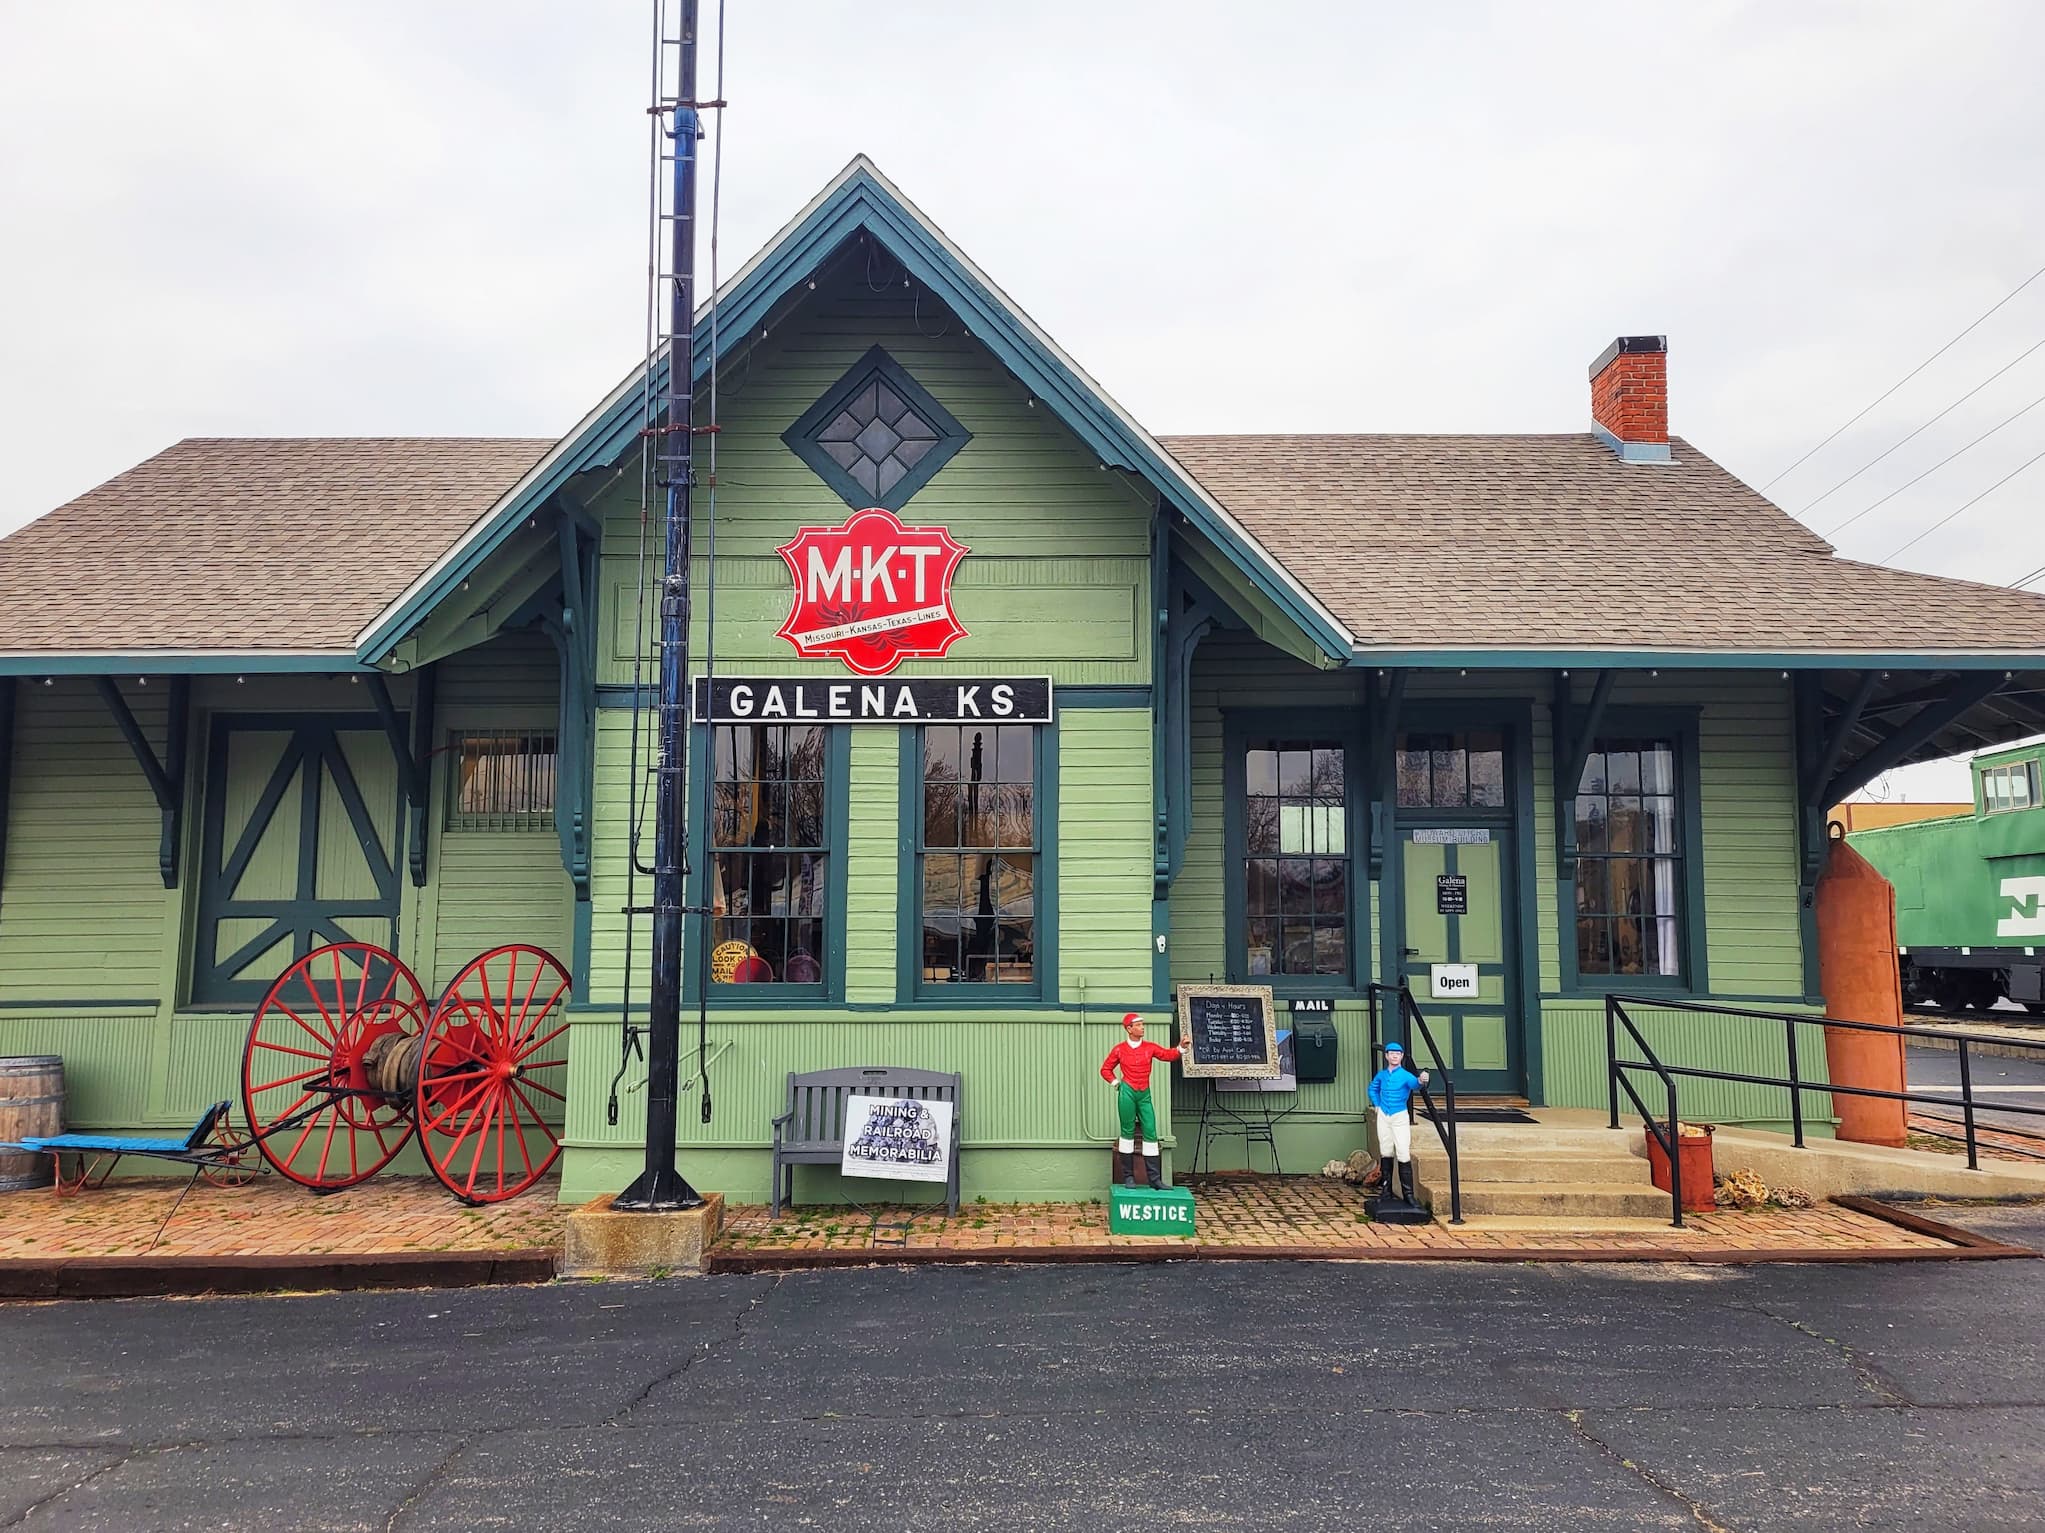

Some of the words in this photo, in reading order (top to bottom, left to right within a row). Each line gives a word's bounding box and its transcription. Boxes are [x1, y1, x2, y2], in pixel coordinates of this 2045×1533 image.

[1438, 876, 1465, 884] Galena
[712, 967, 734, 975] MAIL
[1440, 976, 1470, 990] Open
[1228, 1001, 1246, 1010] Hours
[1295, 1000, 1329, 1011] MAIL
[869, 1104, 917, 1118] MINING
[920, 1108, 930, 1119] &
[863, 1125, 931, 1140] RAILROAD
[849, 1144, 942, 1161] MEMORABILIA
